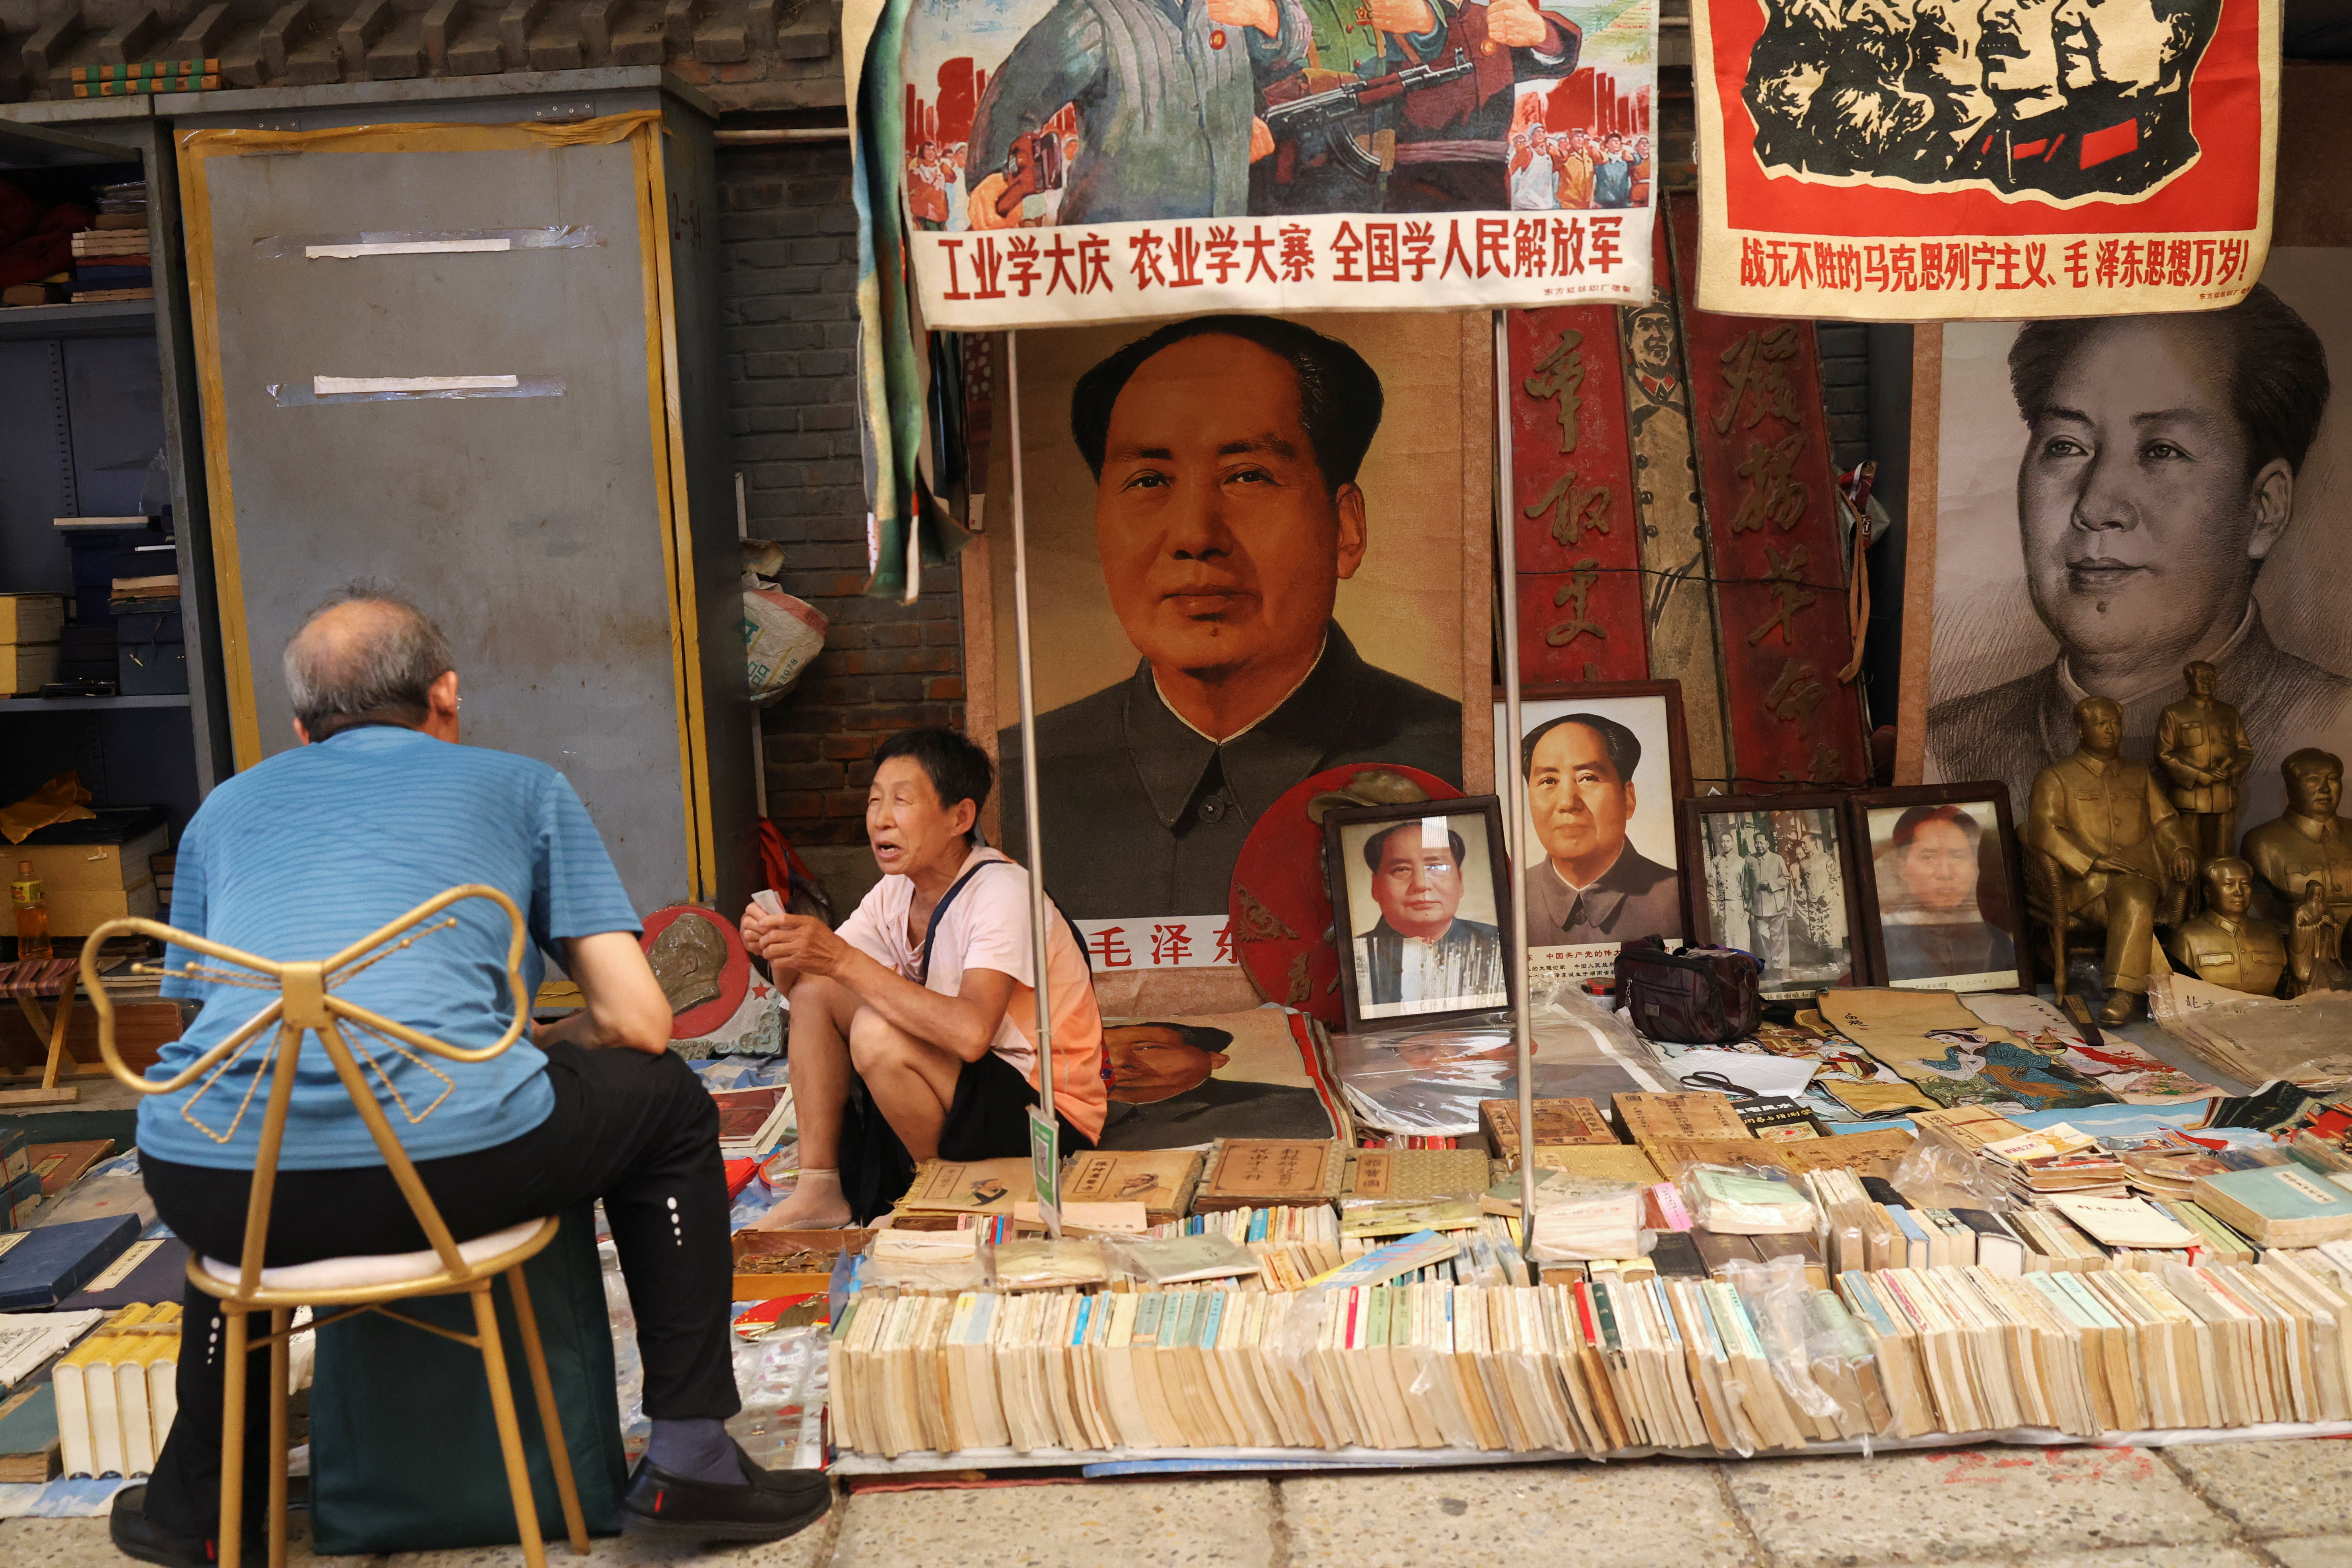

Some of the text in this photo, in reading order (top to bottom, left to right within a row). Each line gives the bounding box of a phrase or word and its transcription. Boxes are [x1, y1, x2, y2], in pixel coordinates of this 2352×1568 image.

[938, 216, 1624, 300] 工业学大庆 农业学大寨 全国学人民解放军
[1546, 949, 1621, 960] 中国共产党的伟大
